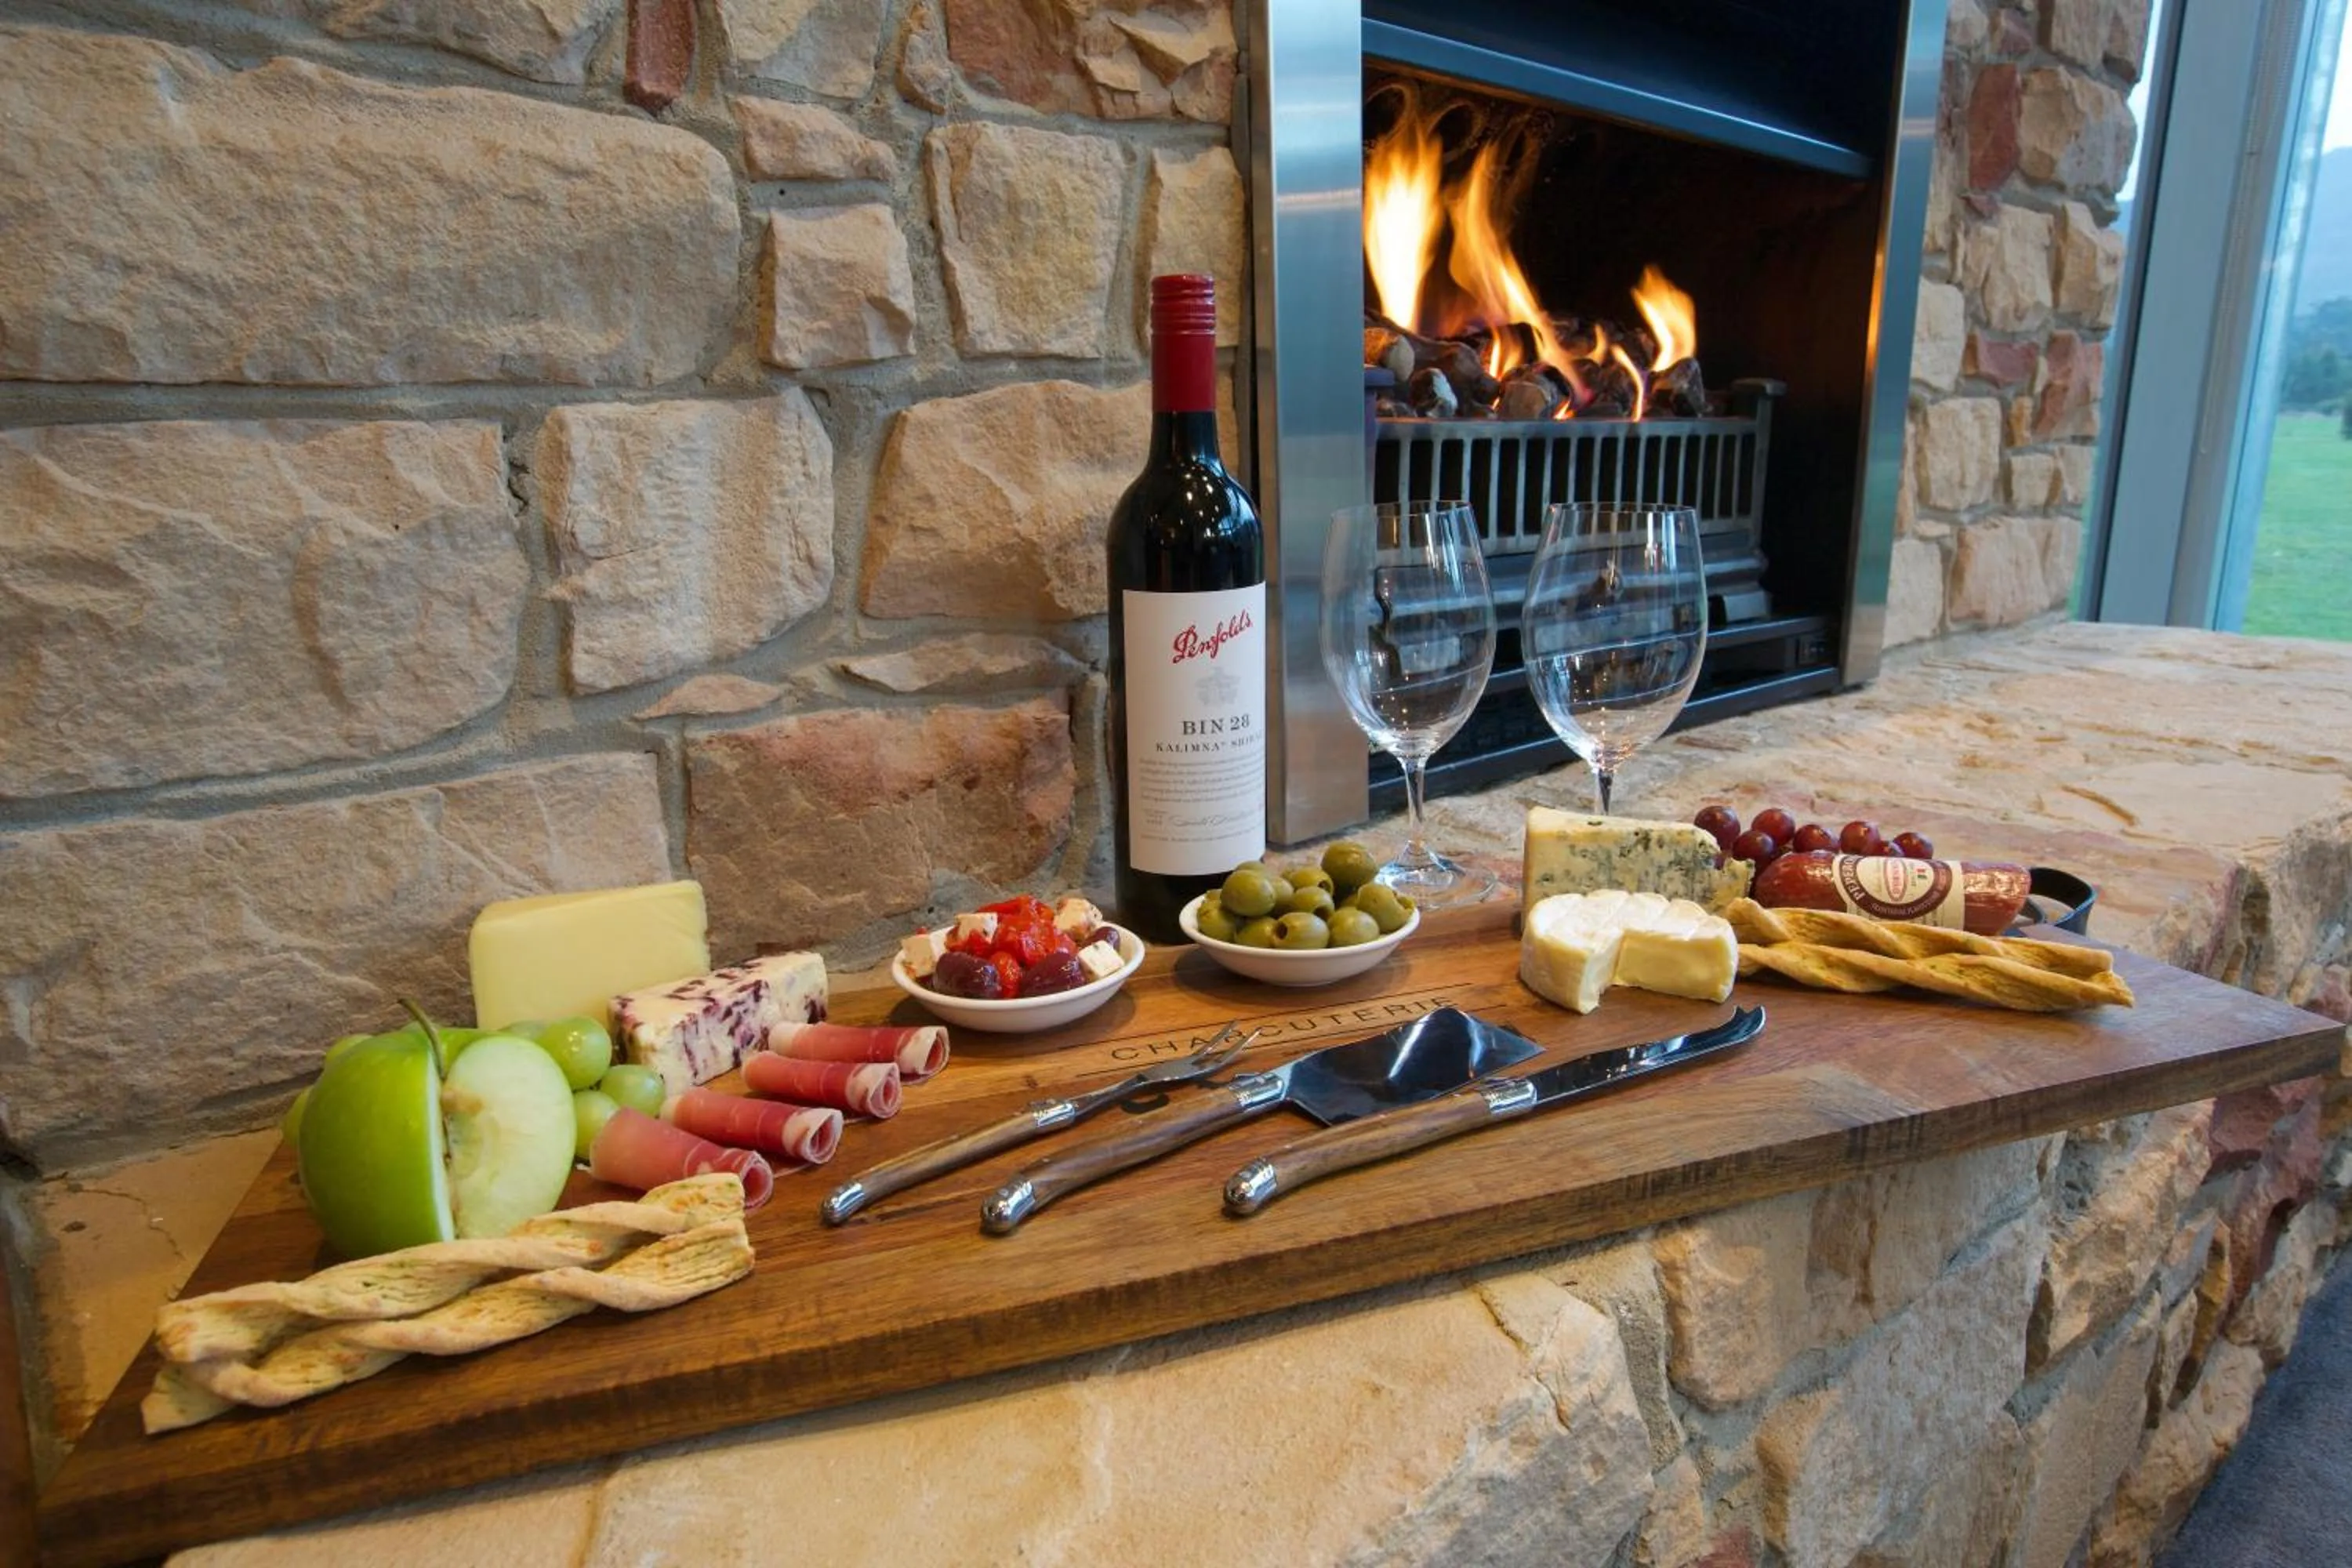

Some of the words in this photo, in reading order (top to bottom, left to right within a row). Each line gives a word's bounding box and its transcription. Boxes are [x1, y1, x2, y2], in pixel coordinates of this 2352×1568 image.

[1172, 608, 1253, 664] Penfolds
[1182, 718, 1224, 735] BIN
[1230, 714, 1250, 731] 28
[1231, 731, 1261, 747] SHIRA
